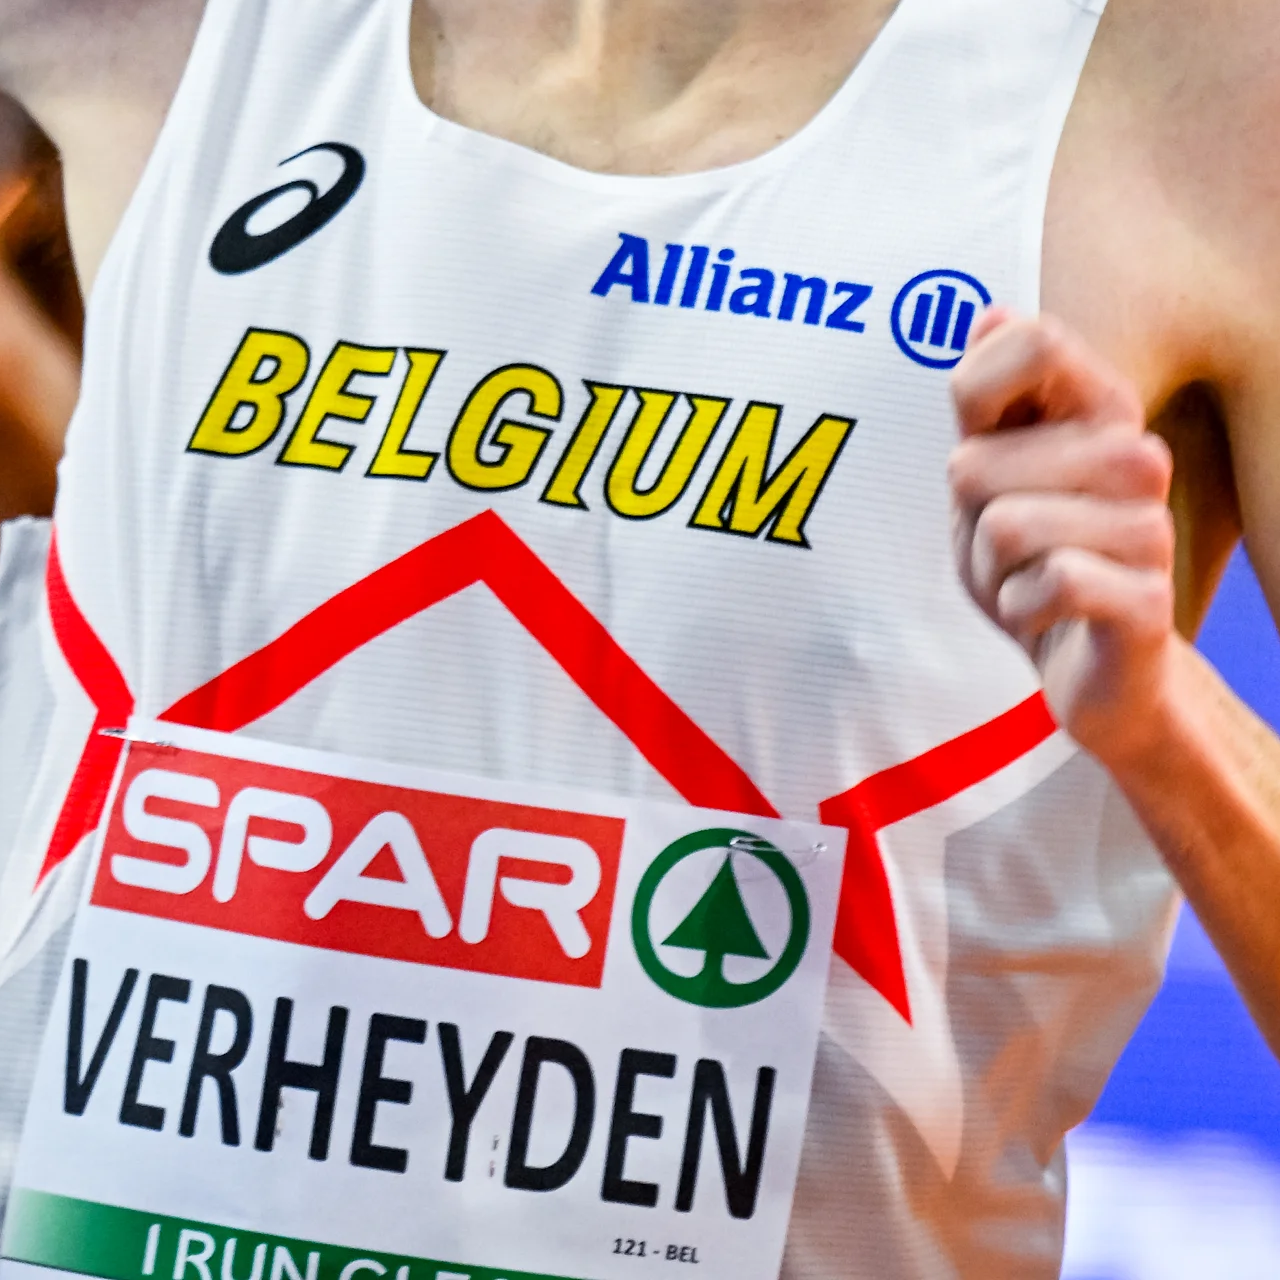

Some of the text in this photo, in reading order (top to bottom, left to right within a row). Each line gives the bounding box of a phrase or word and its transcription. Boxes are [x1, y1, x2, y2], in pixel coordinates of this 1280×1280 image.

[591, 231, 873, 333] Allianz
[186, 326, 857, 549] BELGIUM
[109, 767, 602, 959] SPAR
[62, 957, 777, 1220] VERHEYDEN
[141, 1223, 161, 1276] I
[172, 1228, 320, 1280] RUN
[612, 1238, 647, 1257] 121
[665, 1244, 700, 1264] BEL
